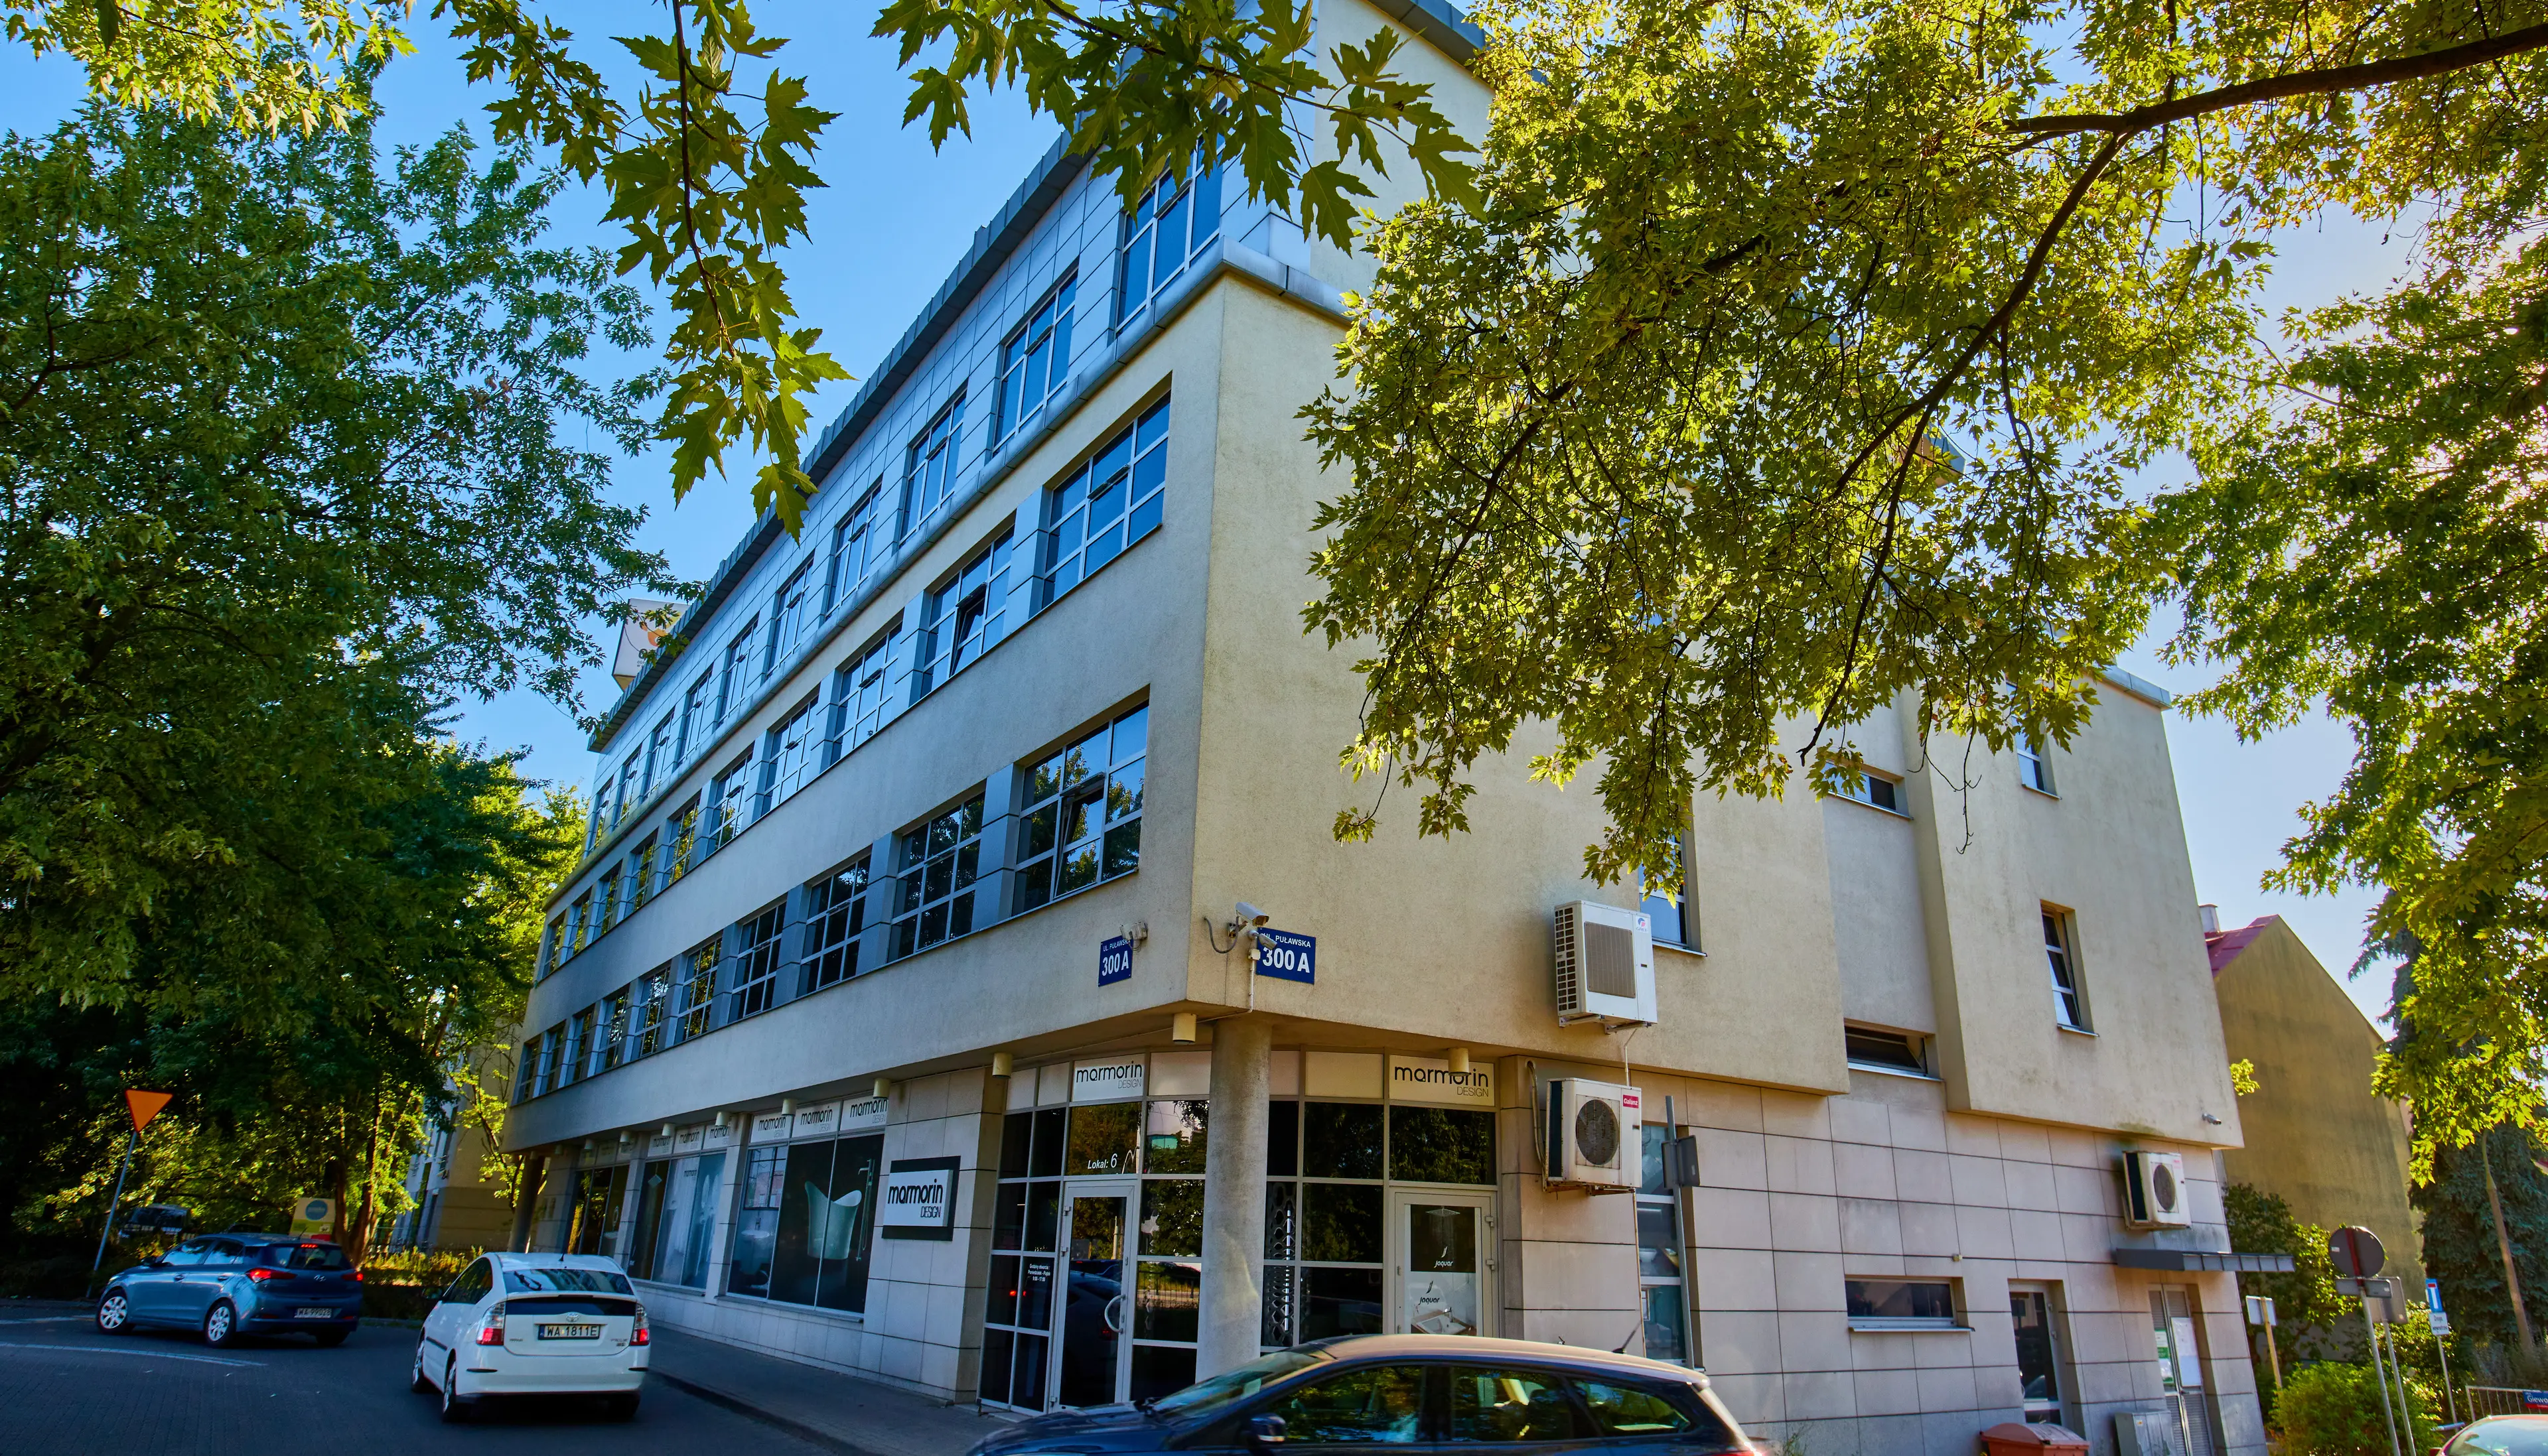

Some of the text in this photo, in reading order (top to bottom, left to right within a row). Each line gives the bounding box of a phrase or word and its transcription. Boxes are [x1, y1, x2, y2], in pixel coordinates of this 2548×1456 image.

[1275, 935, 1311, 948] PUŁAWSKA
[1101, 950, 1129, 976] 300 A
[1263, 947, 1310, 973] 300 A
[1076, 1061, 1142, 1083] marmorin
[1395, 1066, 1488, 1087] marmorin
[1118, 1079, 1142, 1089] DESIGN
[1456, 1087, 1489, 1097] DESIGN
[800, 1106, 833, 1125] marmorin
[850, 1098, 888, 1118] marmorin
[758, 1116, 786, 1131] marmorin
[1087, 1154, 1118, 1169] Lokal: 6
[887, 1178, 944, 1204] marmorin
[920, 1206, 942, 1218] DESIGN
[547, 1326, 597, 1337] WA 1811E
